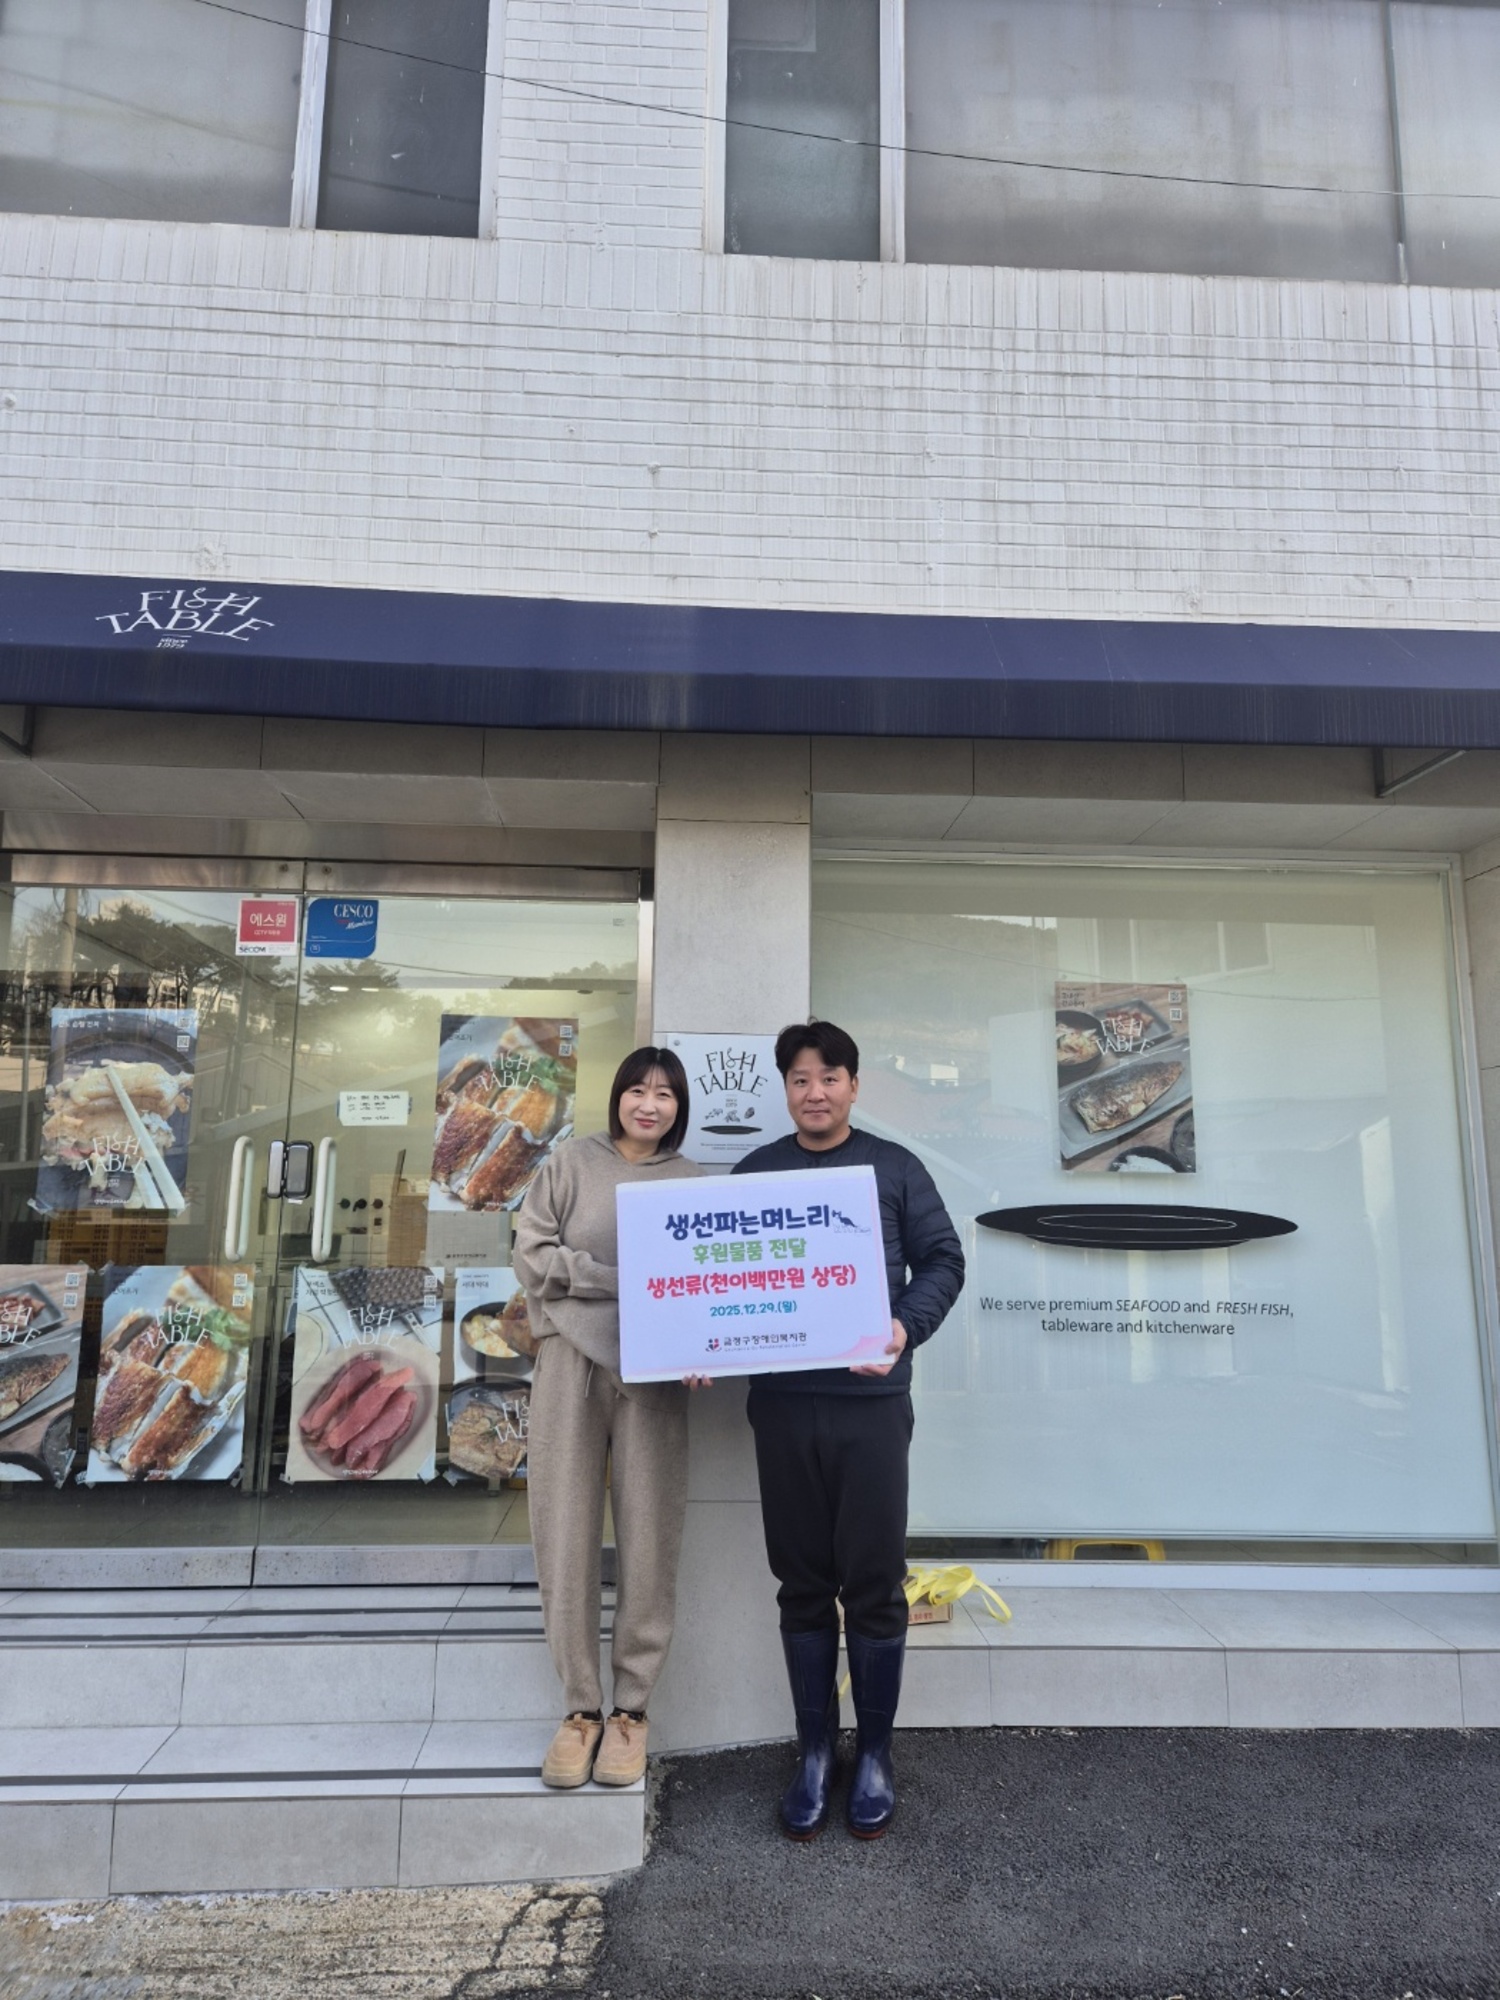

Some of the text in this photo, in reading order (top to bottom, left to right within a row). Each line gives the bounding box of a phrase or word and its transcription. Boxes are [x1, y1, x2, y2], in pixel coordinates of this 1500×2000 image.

[138, 587, 262, 616] FISH
[95, 610, 276, 642] TABLE
[249, 912, 287, 928] 에스원
[333, 903, 374, 919] CESCO
[1095, 1035, 1155, 1058] TABLE
[487, 1049, 532, 1072] FISH
[705, 1047, 757, 1073] FISH
[475, 1070, 542, 1094] TABLE
[693, 1070, 769, 1097] TABLE
[92, 1132, 141, 1155] FISH
[665, 1204, 830, 1241] 생선파는며느리
[692, 1237, 807, 1264] 후원물품 전달
[647, 1264, 856, 1299] 생선류(천이백만원 상당)
[0, 1301, 33, 1326] SH
[155, 1302, 203, 1327] FISH
[347, 1303, 395, 1328] FISH
[710, 1300, 797, 1317] 2025.12.29.(월)
[980, 1297, 1294, 1318] We serve premium SEAFOOD and FRESH FISH,
[0, 1324, 42, 1349] BLE
[141, 1325, 213, 1349] TABLE
[1041, 1318, 1235, 1335] tableware and kitchenware
[724, 1332, 807, 1347] 금정구장애인복지관
[502, 1395, 530, 1421] FIS
[491, 1418, 529, 1444] TAB
